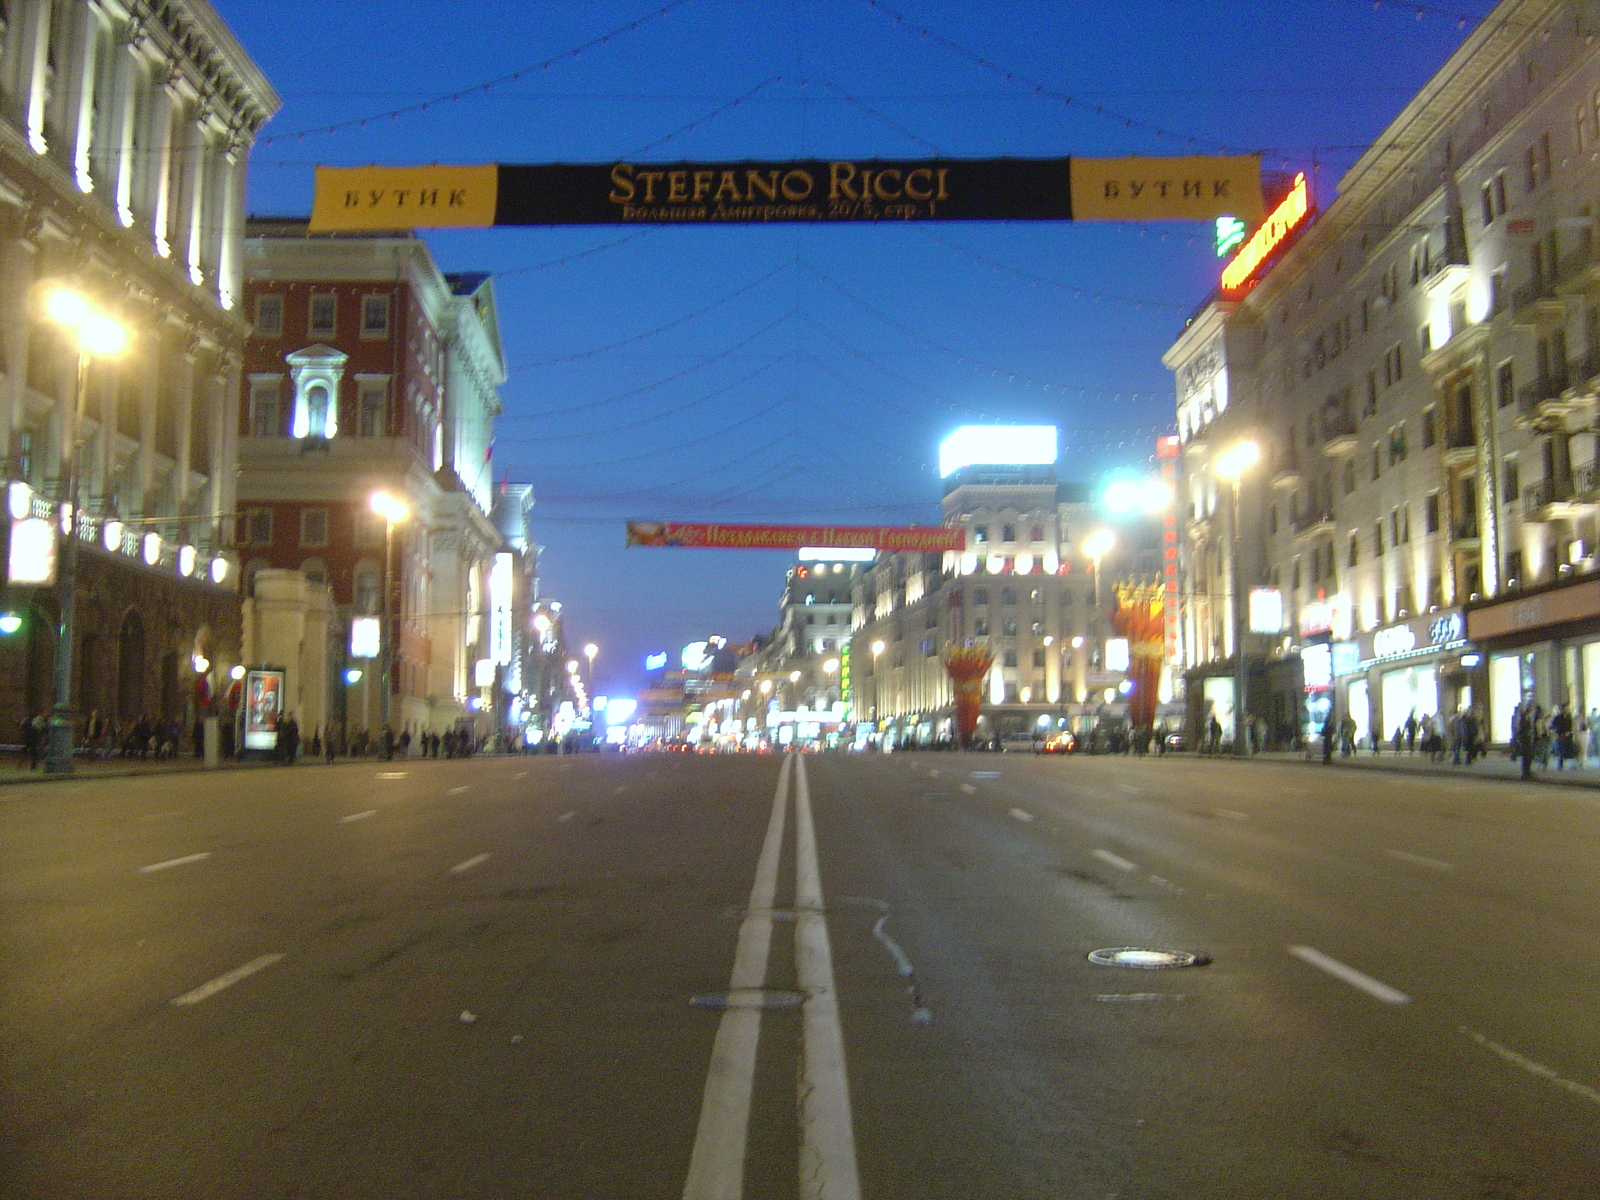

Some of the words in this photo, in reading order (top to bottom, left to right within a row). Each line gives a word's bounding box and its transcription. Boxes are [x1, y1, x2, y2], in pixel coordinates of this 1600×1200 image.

[609, 163, 813, 203] STEFANO
[828, 161, 950, 201] RICCI
[1103, 179, 1231, 198] БУТИК
[344, 188, 467, 208] БУТИК
[622, 201, 707, 220] Большая
